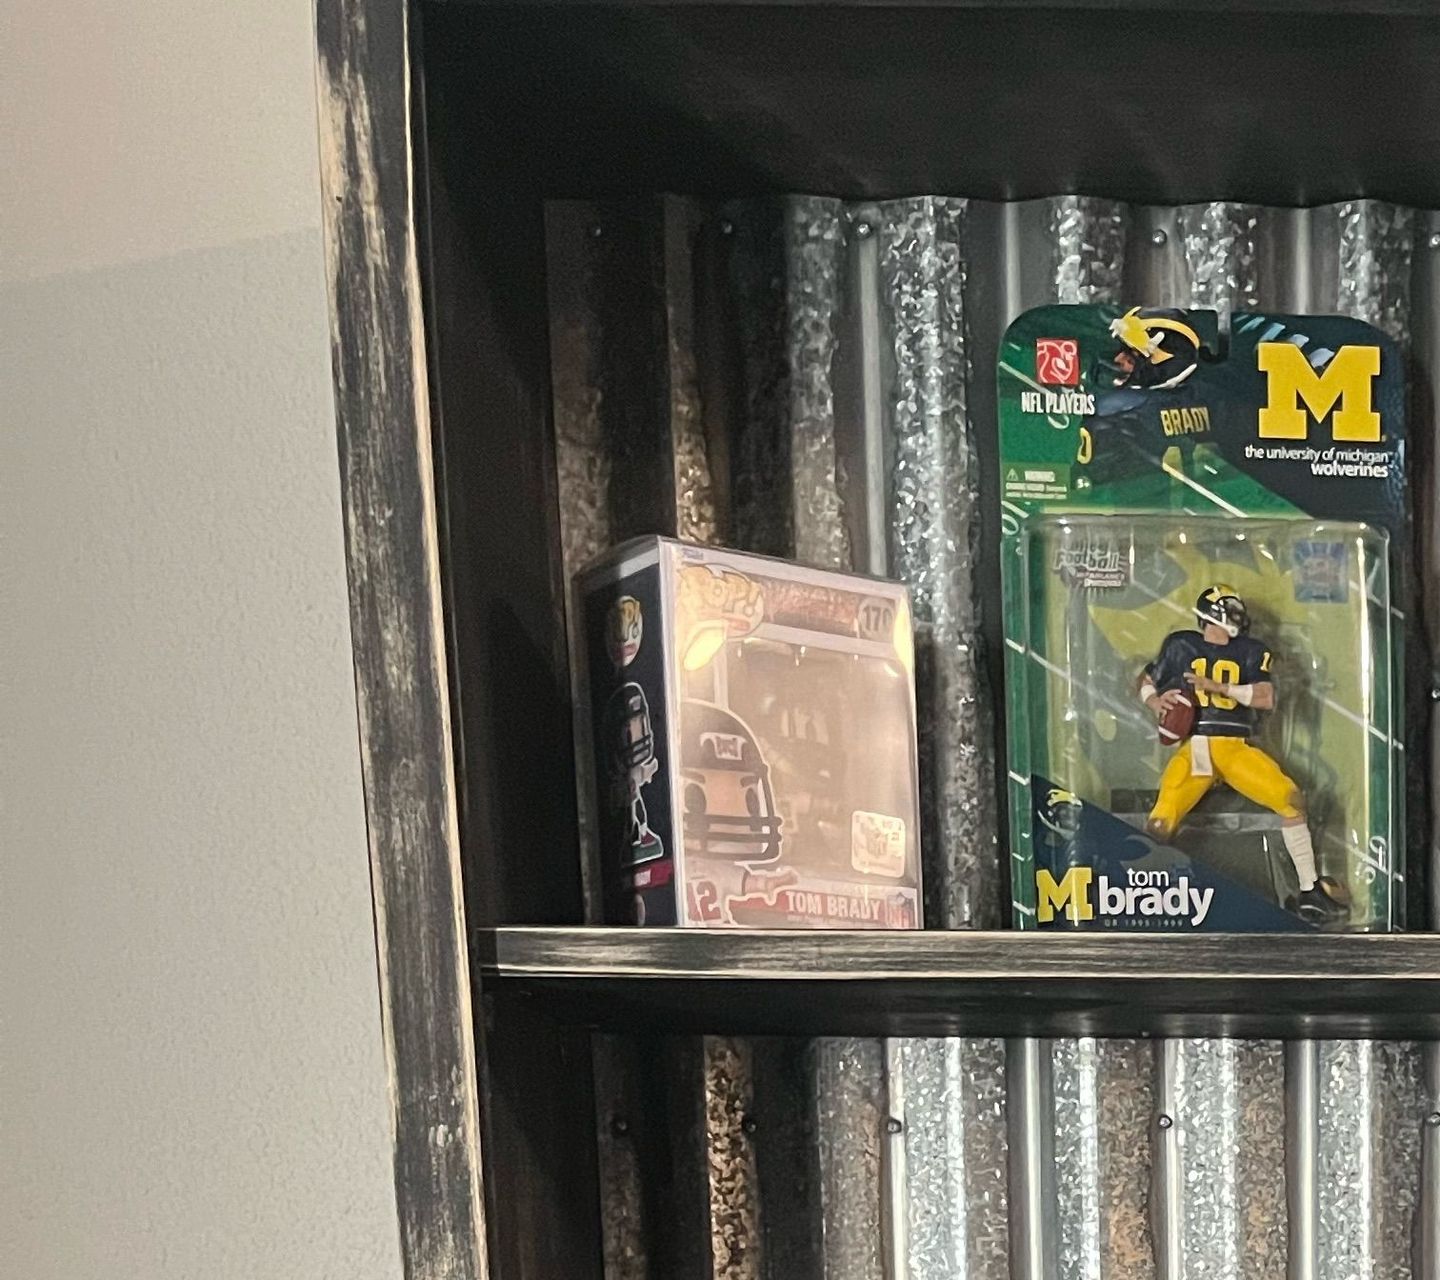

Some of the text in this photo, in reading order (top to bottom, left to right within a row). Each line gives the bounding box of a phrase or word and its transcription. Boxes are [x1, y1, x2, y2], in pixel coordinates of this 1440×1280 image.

[1021, 392, 1096, 415] NFL PLAYERS
[1258, 342, 1380, 442] M
[1160, 407, 1211, 436] BRADY
[1245, 445, 1389, 465] the university of michigan
[1310, 461, 1389, 478] wolverines
[1126, 868, 1169, 887] tom
[786, 891, 881, 920] TOM BRADY
[1036, 867, 1093, 922] M
[1098, 876, 1215, 926] brady
